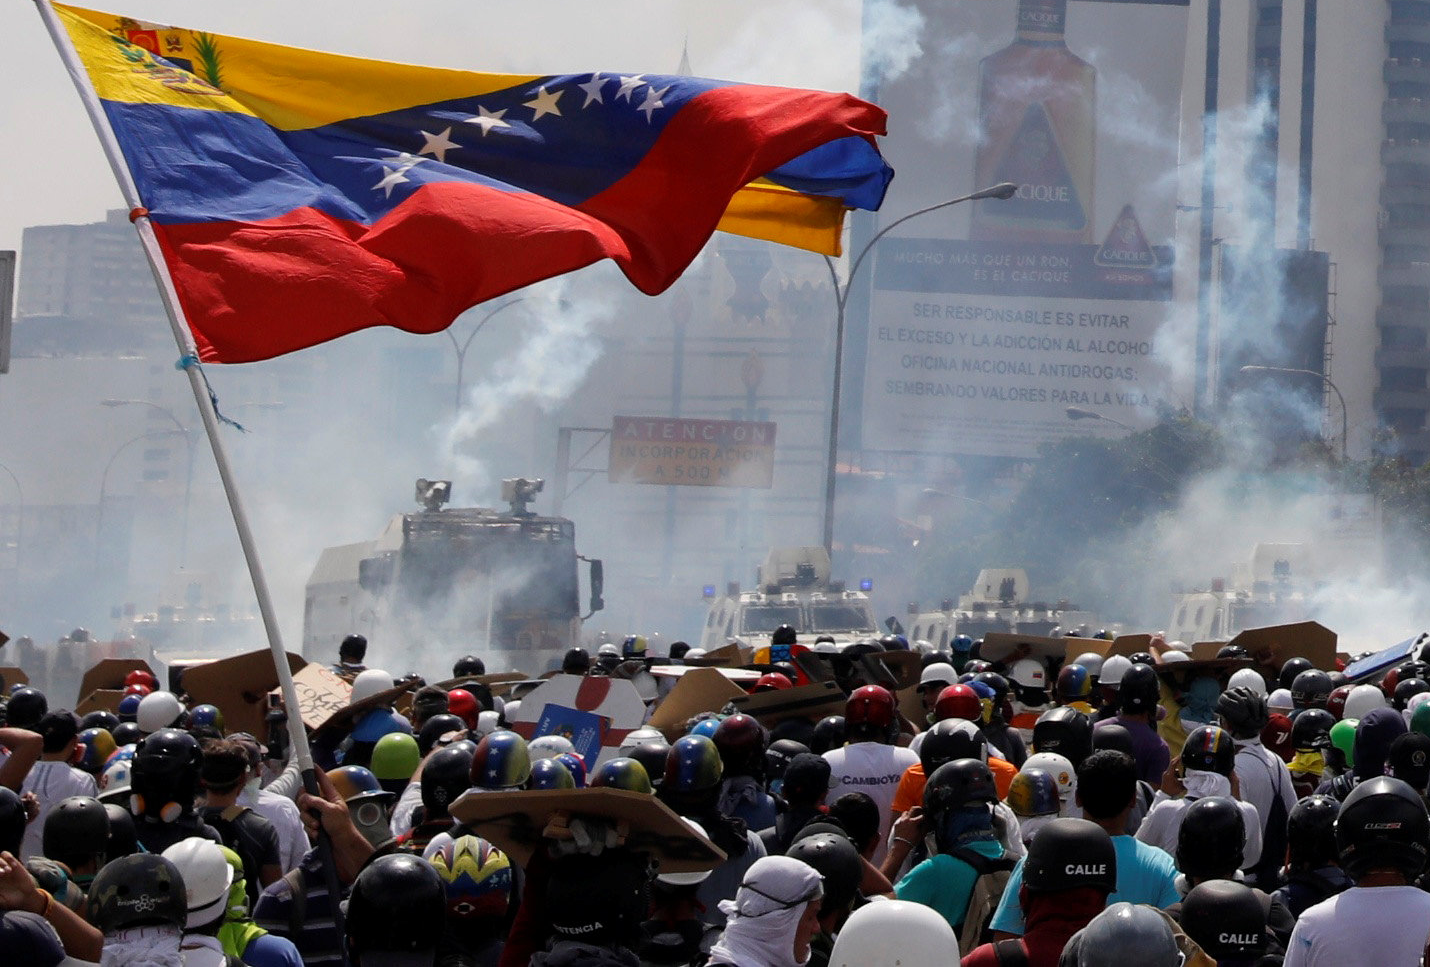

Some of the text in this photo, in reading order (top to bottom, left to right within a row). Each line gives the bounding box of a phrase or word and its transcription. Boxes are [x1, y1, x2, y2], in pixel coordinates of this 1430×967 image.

[1012, 184, 1070, 202] CIQUE
[894, 251, 943, 265] MUCHO
[983, 253, 1011, 267] QUE
[1016, 254, 1036, 268] UN
[973, 269, 989, 281] ES
[993, 269, 1006, 281] EL
[913, 302, 1129, 329] SER RESPONSABLE ES EVITAR
[878, 328, 895, 343] EL
[897, 330, 955, 346] EXCESO
[957, 331, 969, 346] Y
[971, 332, 992, 347] LA
[1065, 337, 1084, 353] AL
[1087, 338, 1154, 356] ALCOHOL
[901, 353, 1139, 382] OFICINA NACIONAL ANTIDROGAS:
[884, 380, 1150, 408] SEMBRANDO VALORES PARA LA VIDA
[655, 465, 666, 477] A
[673, 465, 711, 480] 500
[1065, 864, 1107, 875] CALLE
[1218, 932, 1259, 945] CALLE
